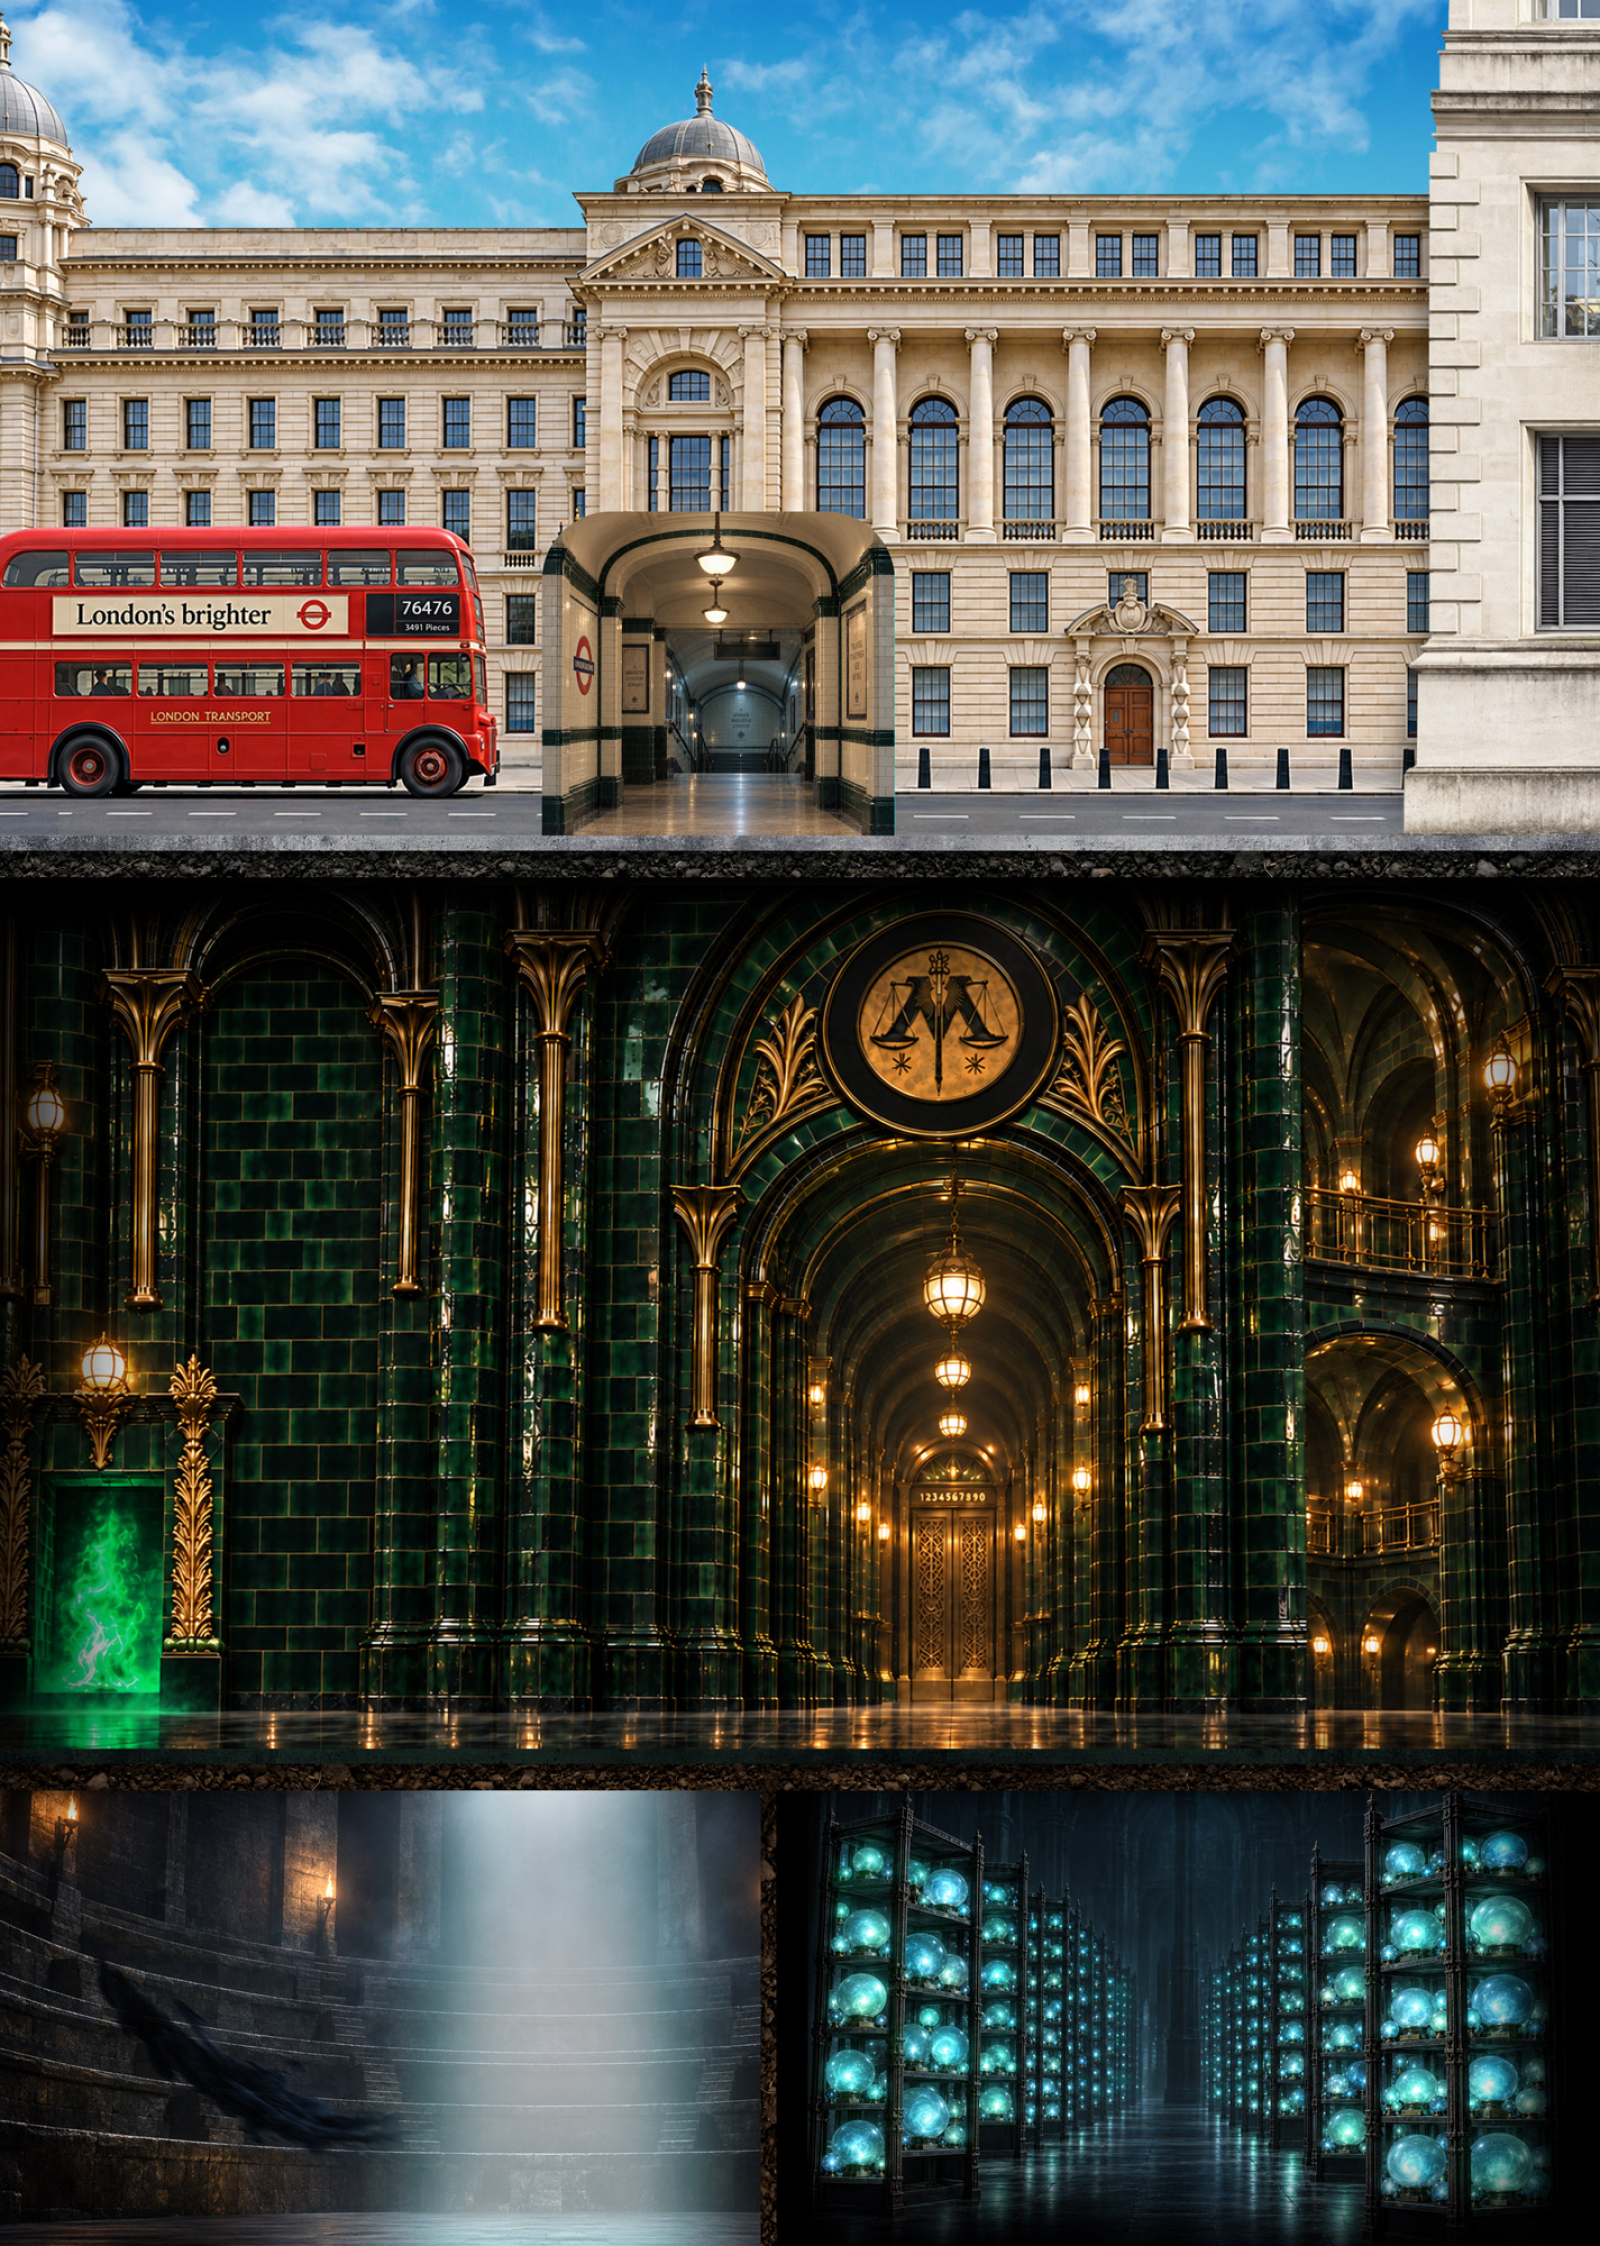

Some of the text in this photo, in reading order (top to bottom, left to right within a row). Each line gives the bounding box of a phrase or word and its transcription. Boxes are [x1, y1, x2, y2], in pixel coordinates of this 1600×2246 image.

[402, 601, 453, 615] 76476
[76, 603, 271, 630] London's brighter
[425, 623, 450, 631] Pieces
[150, 711, 271, 721] LONDON TRANSPORT
[920, 1492, 986, 1501] 1234567890
